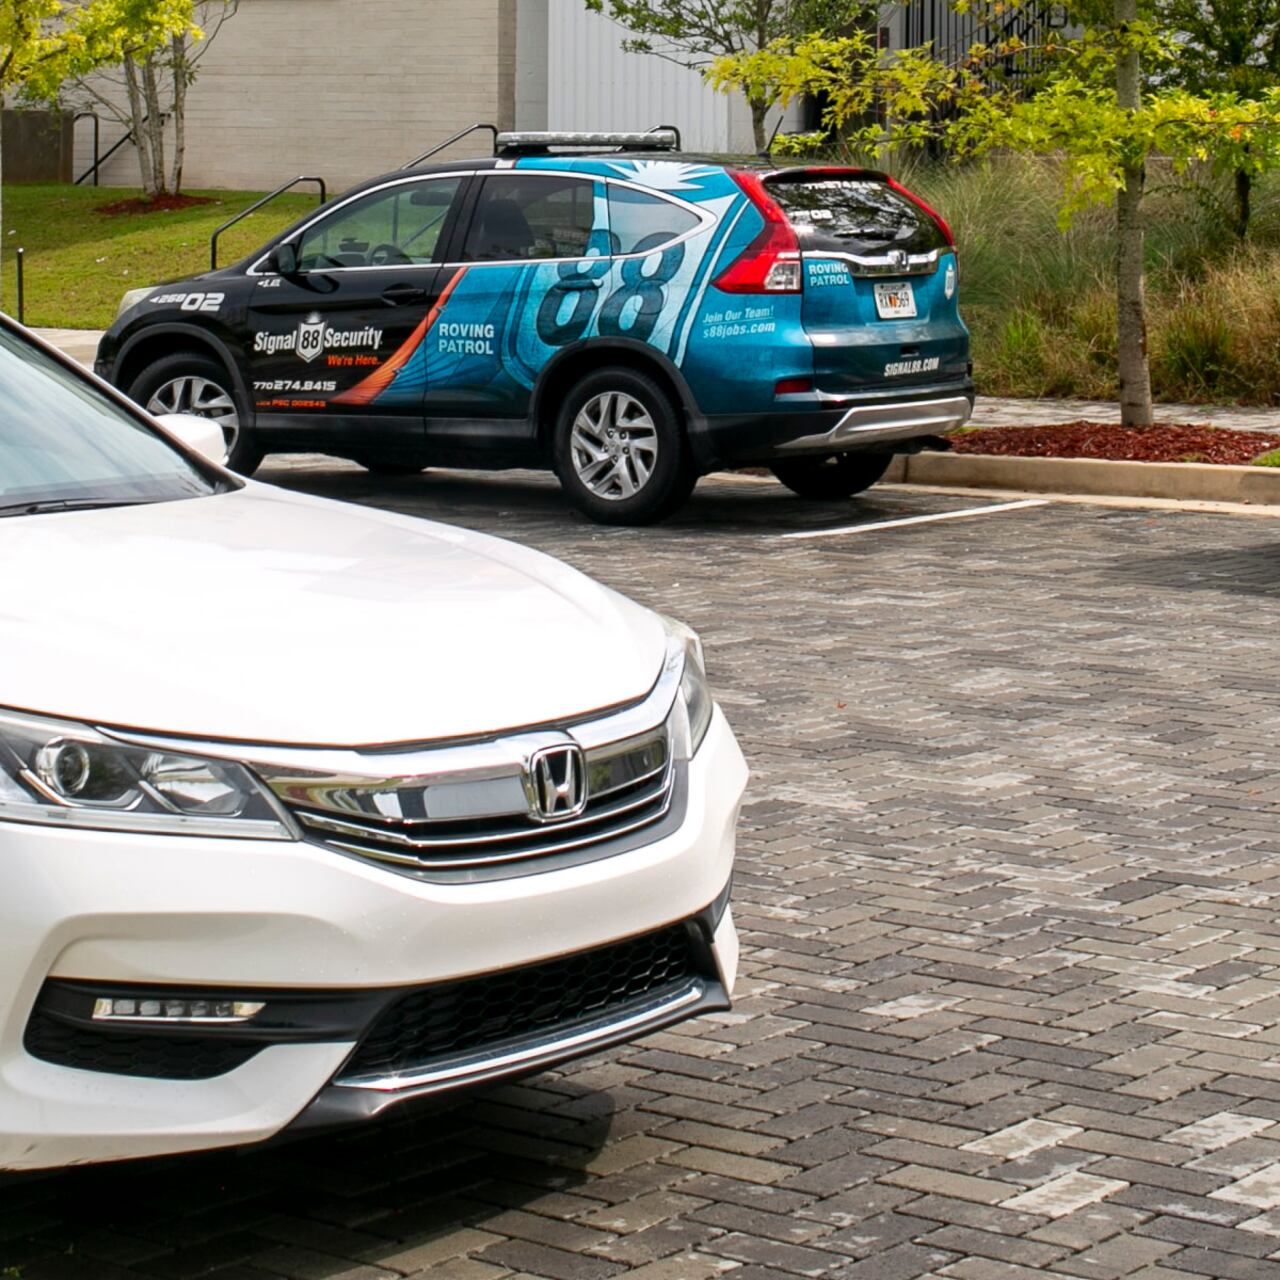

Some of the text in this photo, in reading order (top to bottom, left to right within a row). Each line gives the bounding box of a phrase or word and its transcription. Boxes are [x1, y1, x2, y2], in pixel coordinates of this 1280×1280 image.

[808, 263, 849, 275] ROVING
[536, 229, 686, 346] 88
[810, 274, 850, 286] PATROL
[703, 306, 775, 326] Join Our Team!
[438, 323, 495, 339] ROVING
[703, 322, 776, 339] s88jobs.com
[254, 326, 382, 355] Signal 88 Security
[438, 339, 495, 355] PATROL
[327, 355, 353, 366] We're
[884, 357, 940, 377] SIGNAL88.COM
